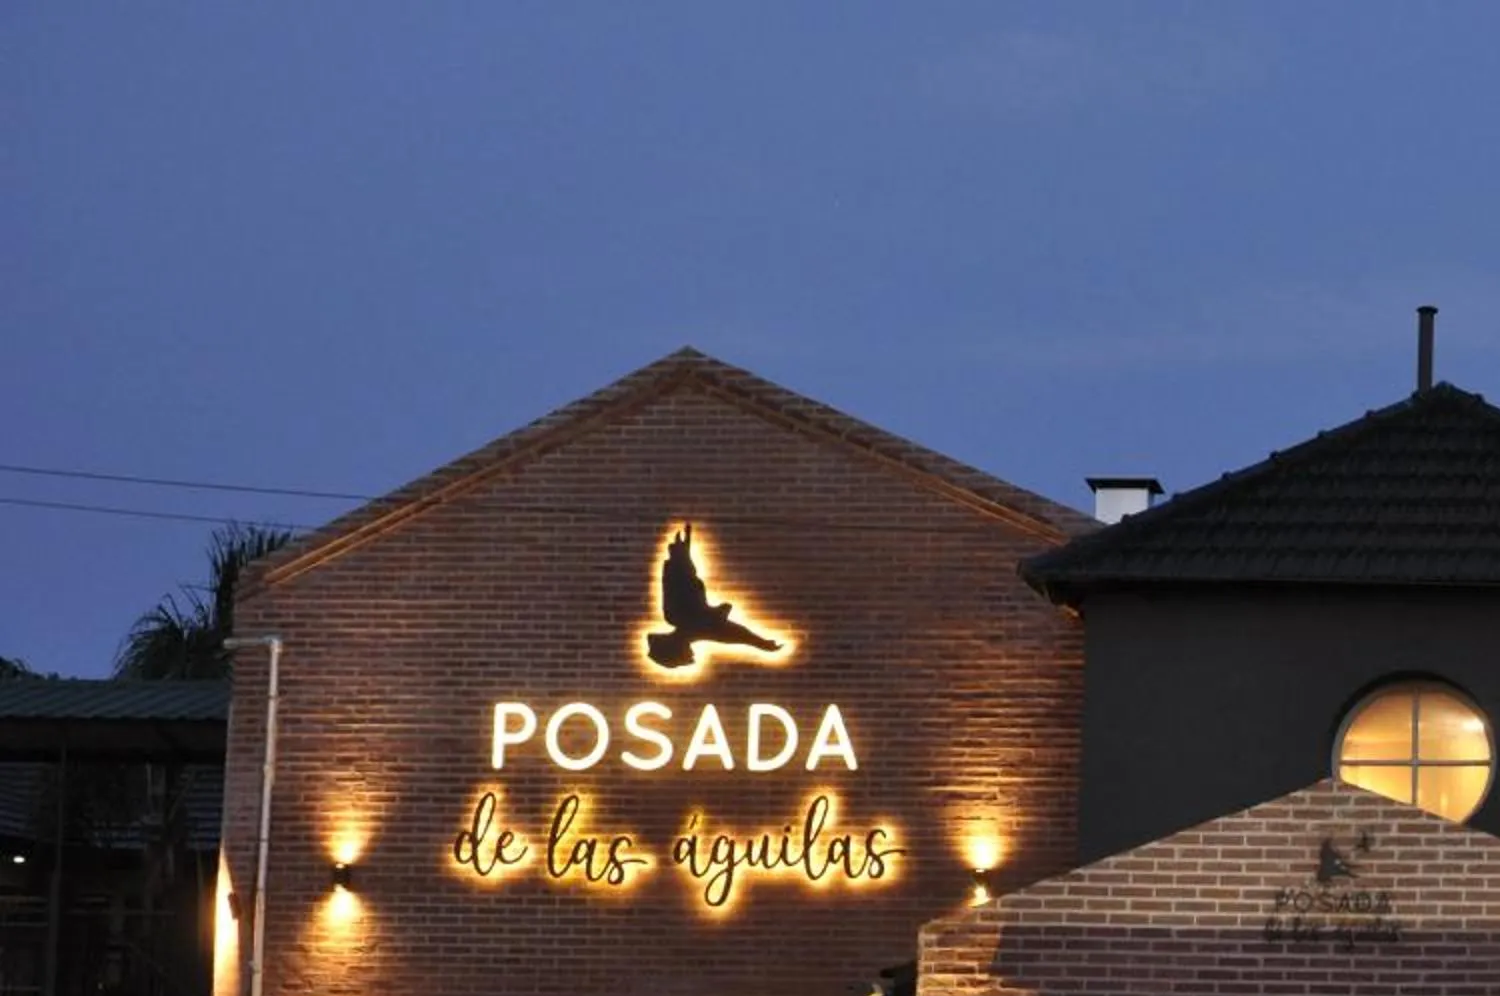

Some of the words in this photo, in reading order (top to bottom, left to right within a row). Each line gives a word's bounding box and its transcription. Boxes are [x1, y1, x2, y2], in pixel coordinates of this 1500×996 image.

[491, 702, 857, 771] POSADA
[453, 792, 528, 877] de
[546, 795, 649, 885] las
[672, 795, 907, 907] águilas
